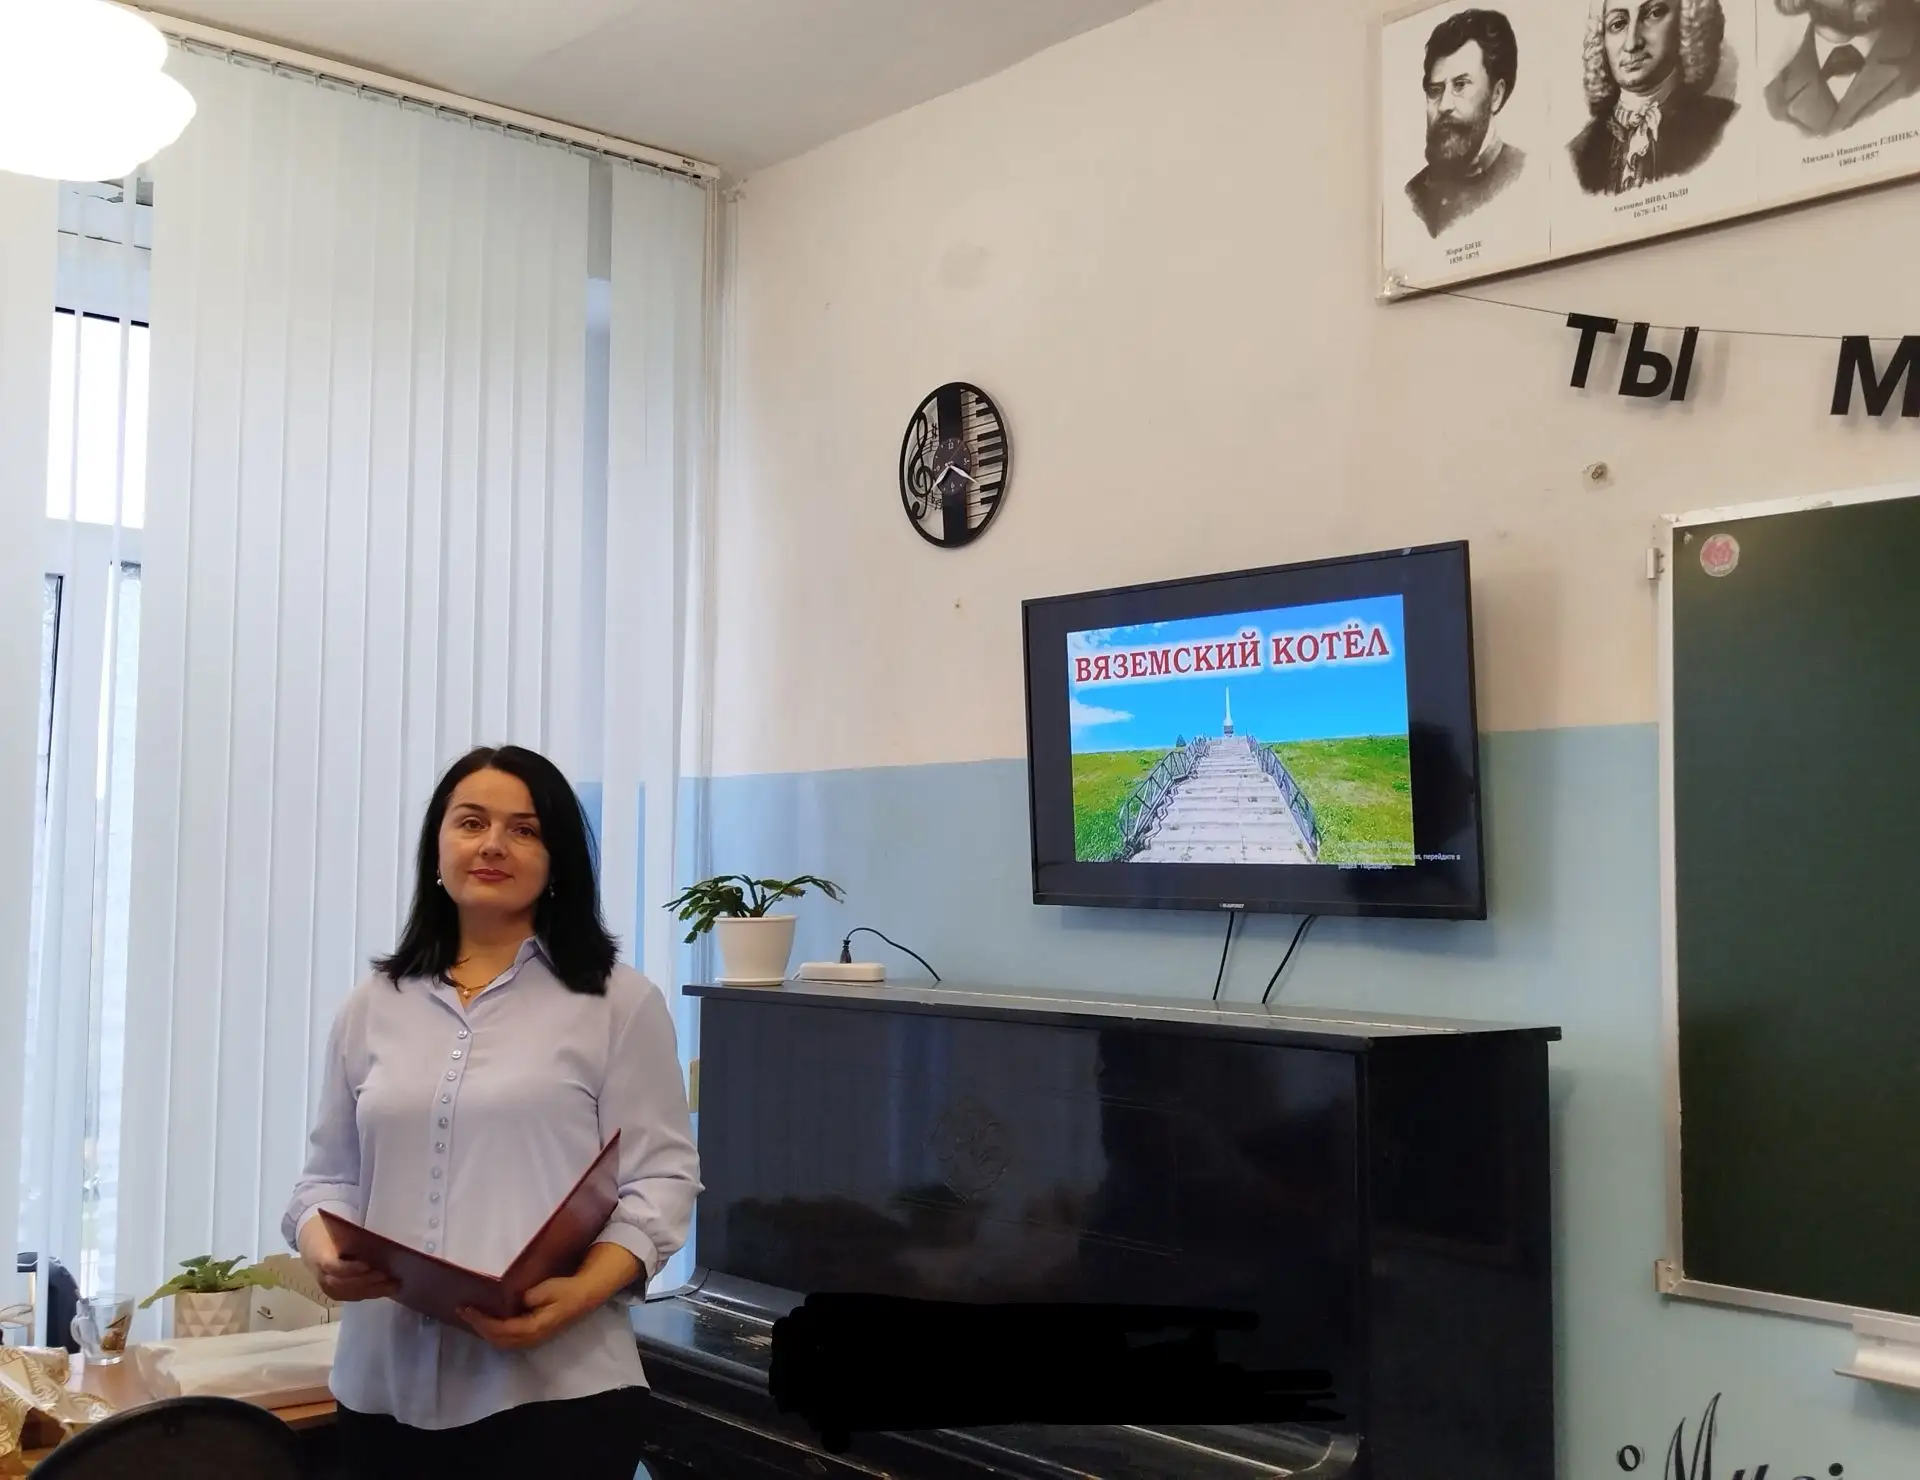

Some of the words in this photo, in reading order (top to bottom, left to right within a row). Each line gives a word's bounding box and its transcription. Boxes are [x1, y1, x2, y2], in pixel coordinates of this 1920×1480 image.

[1566, 312, 1700, 401] ТЫ
[1075, 631, 1261, 682] ВЯЗЕМСКИЙ
[1272, 623, 1390, 665] КОТЁЛ
